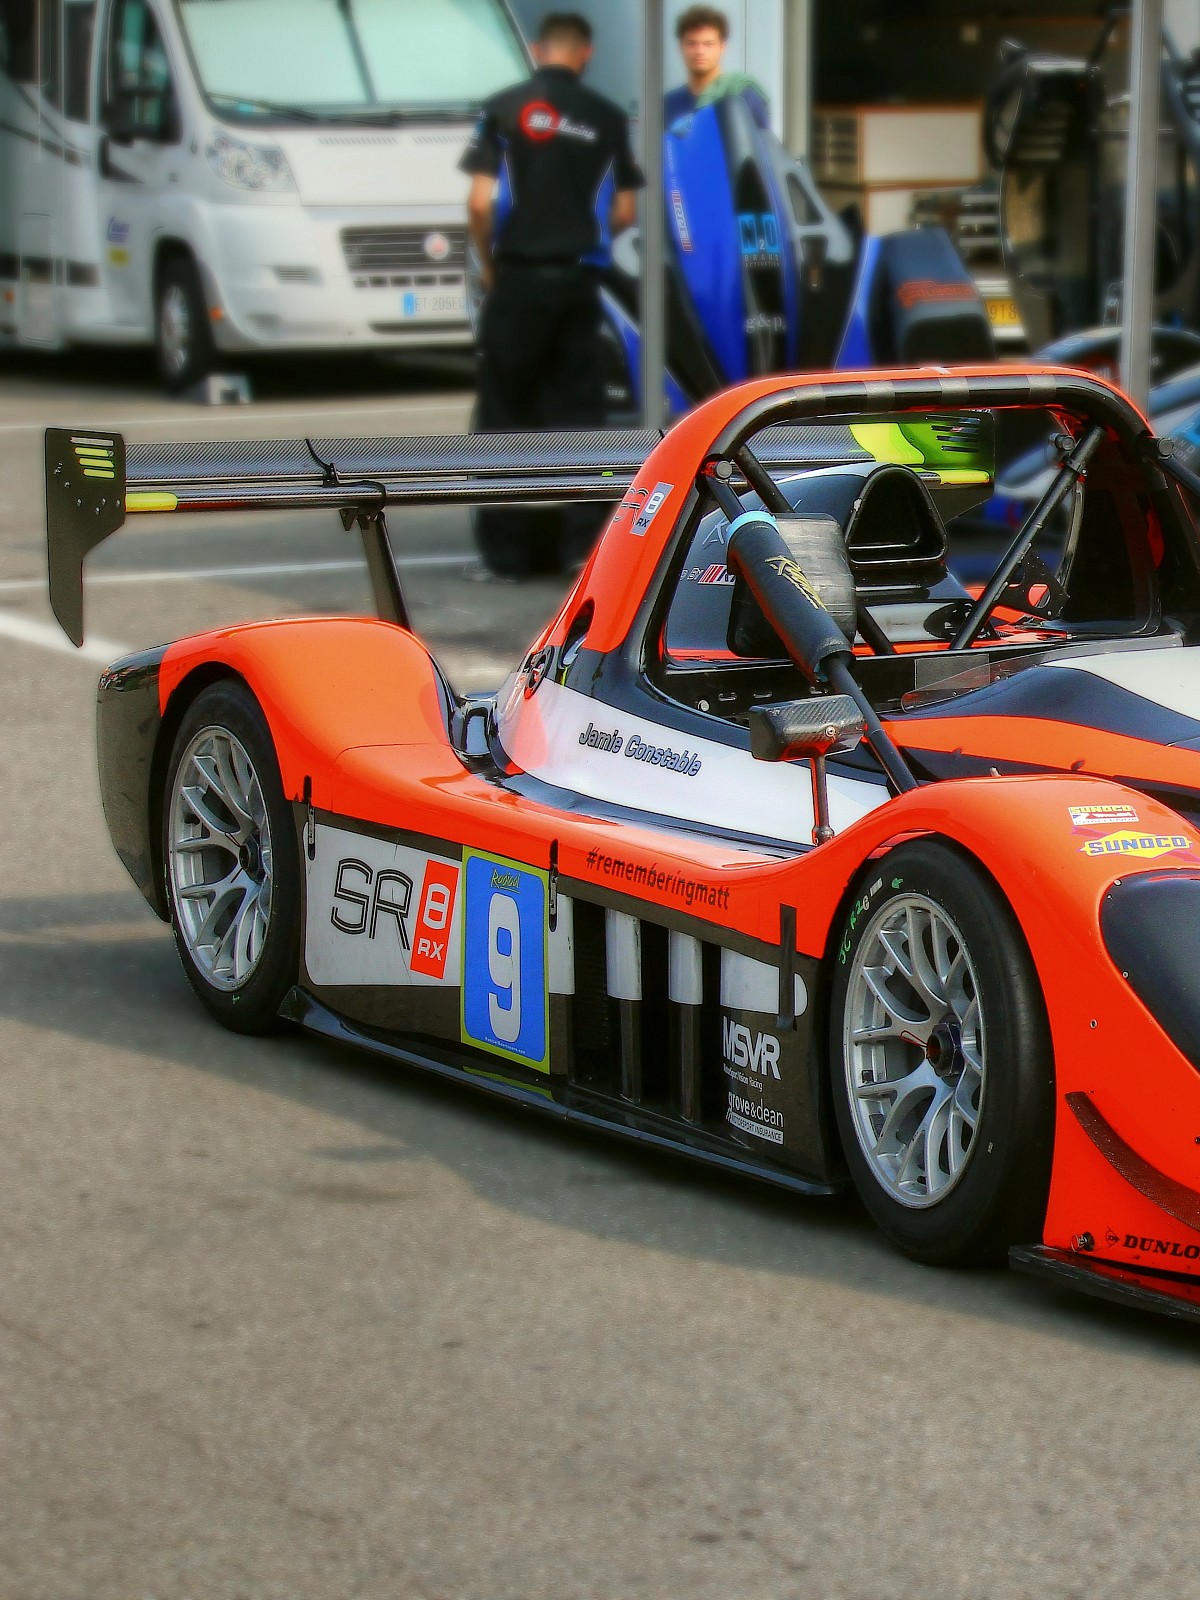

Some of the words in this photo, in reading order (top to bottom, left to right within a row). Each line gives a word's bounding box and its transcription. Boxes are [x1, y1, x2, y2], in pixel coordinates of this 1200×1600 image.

[636, 517, 650, 528] RX
[579, 722, 624, 754] Jamie
[624, 734, 702, 777] Constable
[1088, 837, 1187, 854] SUNOCO
[586, 846, 730, 911] #rememberingmatt
[417, 937, 445, 961] RX
[488, 891, 521, 1043] 9
[723, 1015, 782, 1080] MSVR
[728, 1091, 784, 1128] grove&dean
